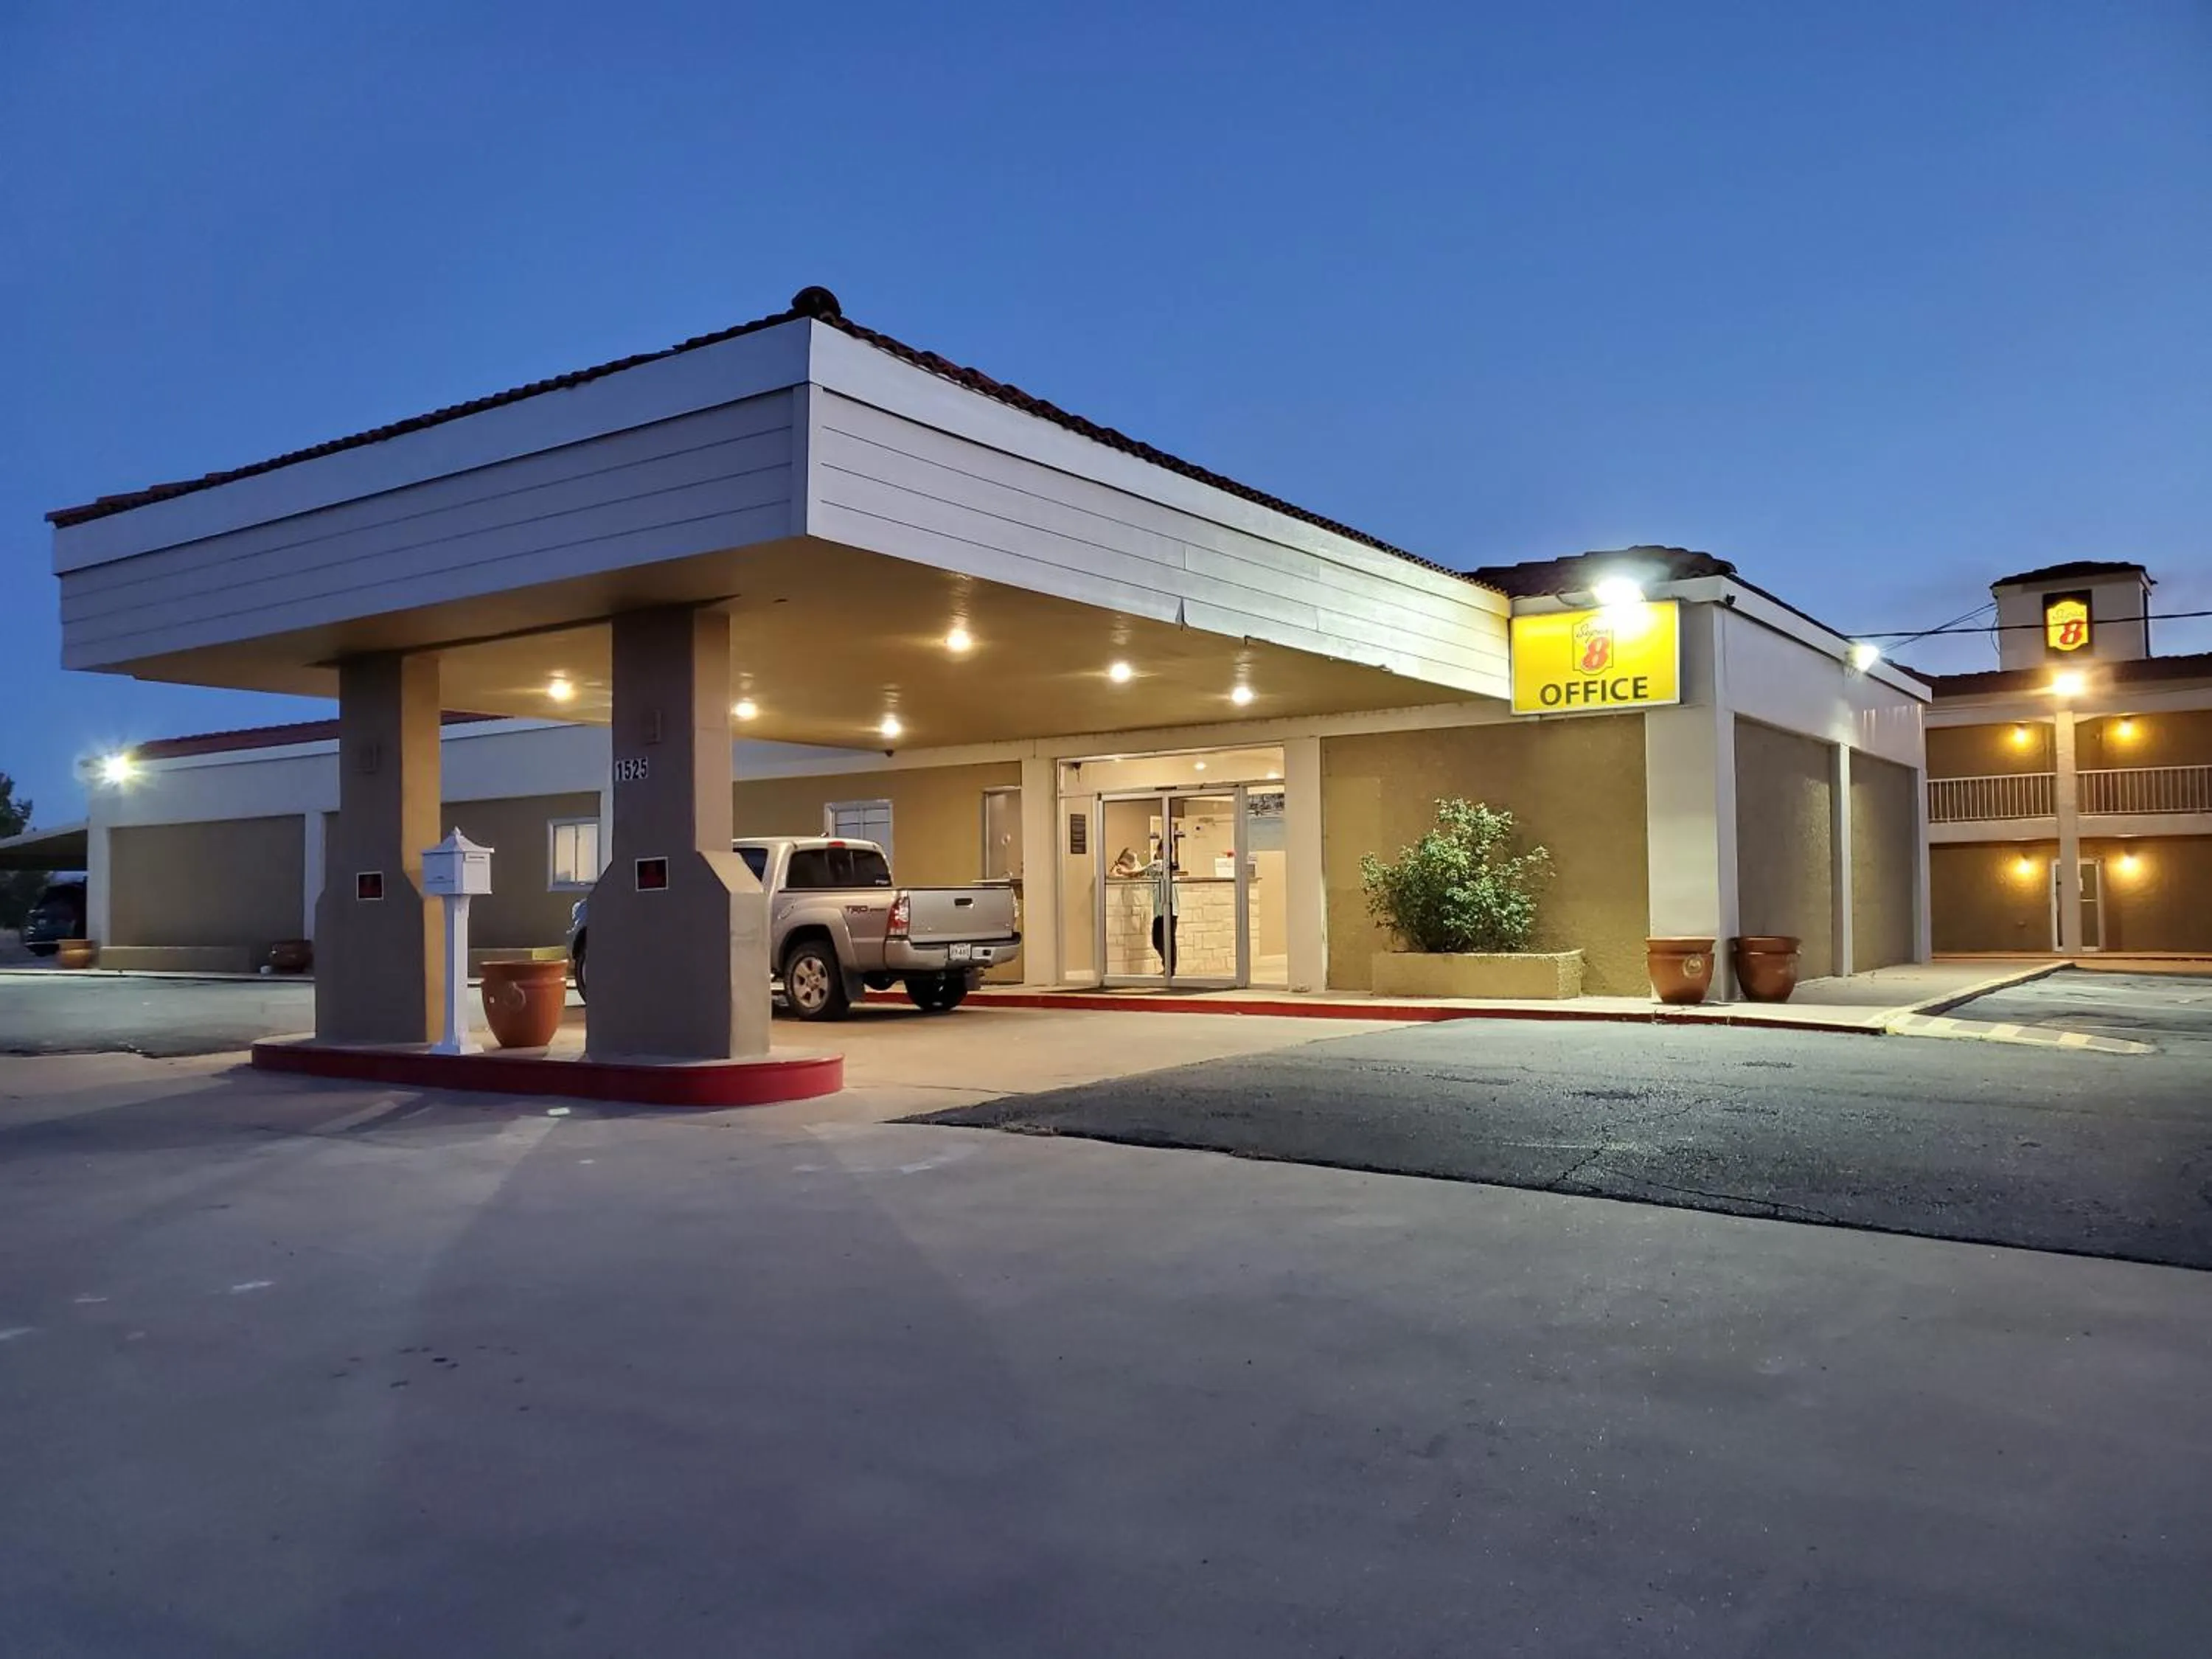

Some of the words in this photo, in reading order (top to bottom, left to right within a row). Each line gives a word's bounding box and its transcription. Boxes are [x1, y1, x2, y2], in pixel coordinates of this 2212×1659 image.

[2059, 619, 2083, 644] 8
[1582, 637, 1610, 671] 8
[1539, 676, 1649, 706] OFFICE
[616, 757, 647, 780] 1525
